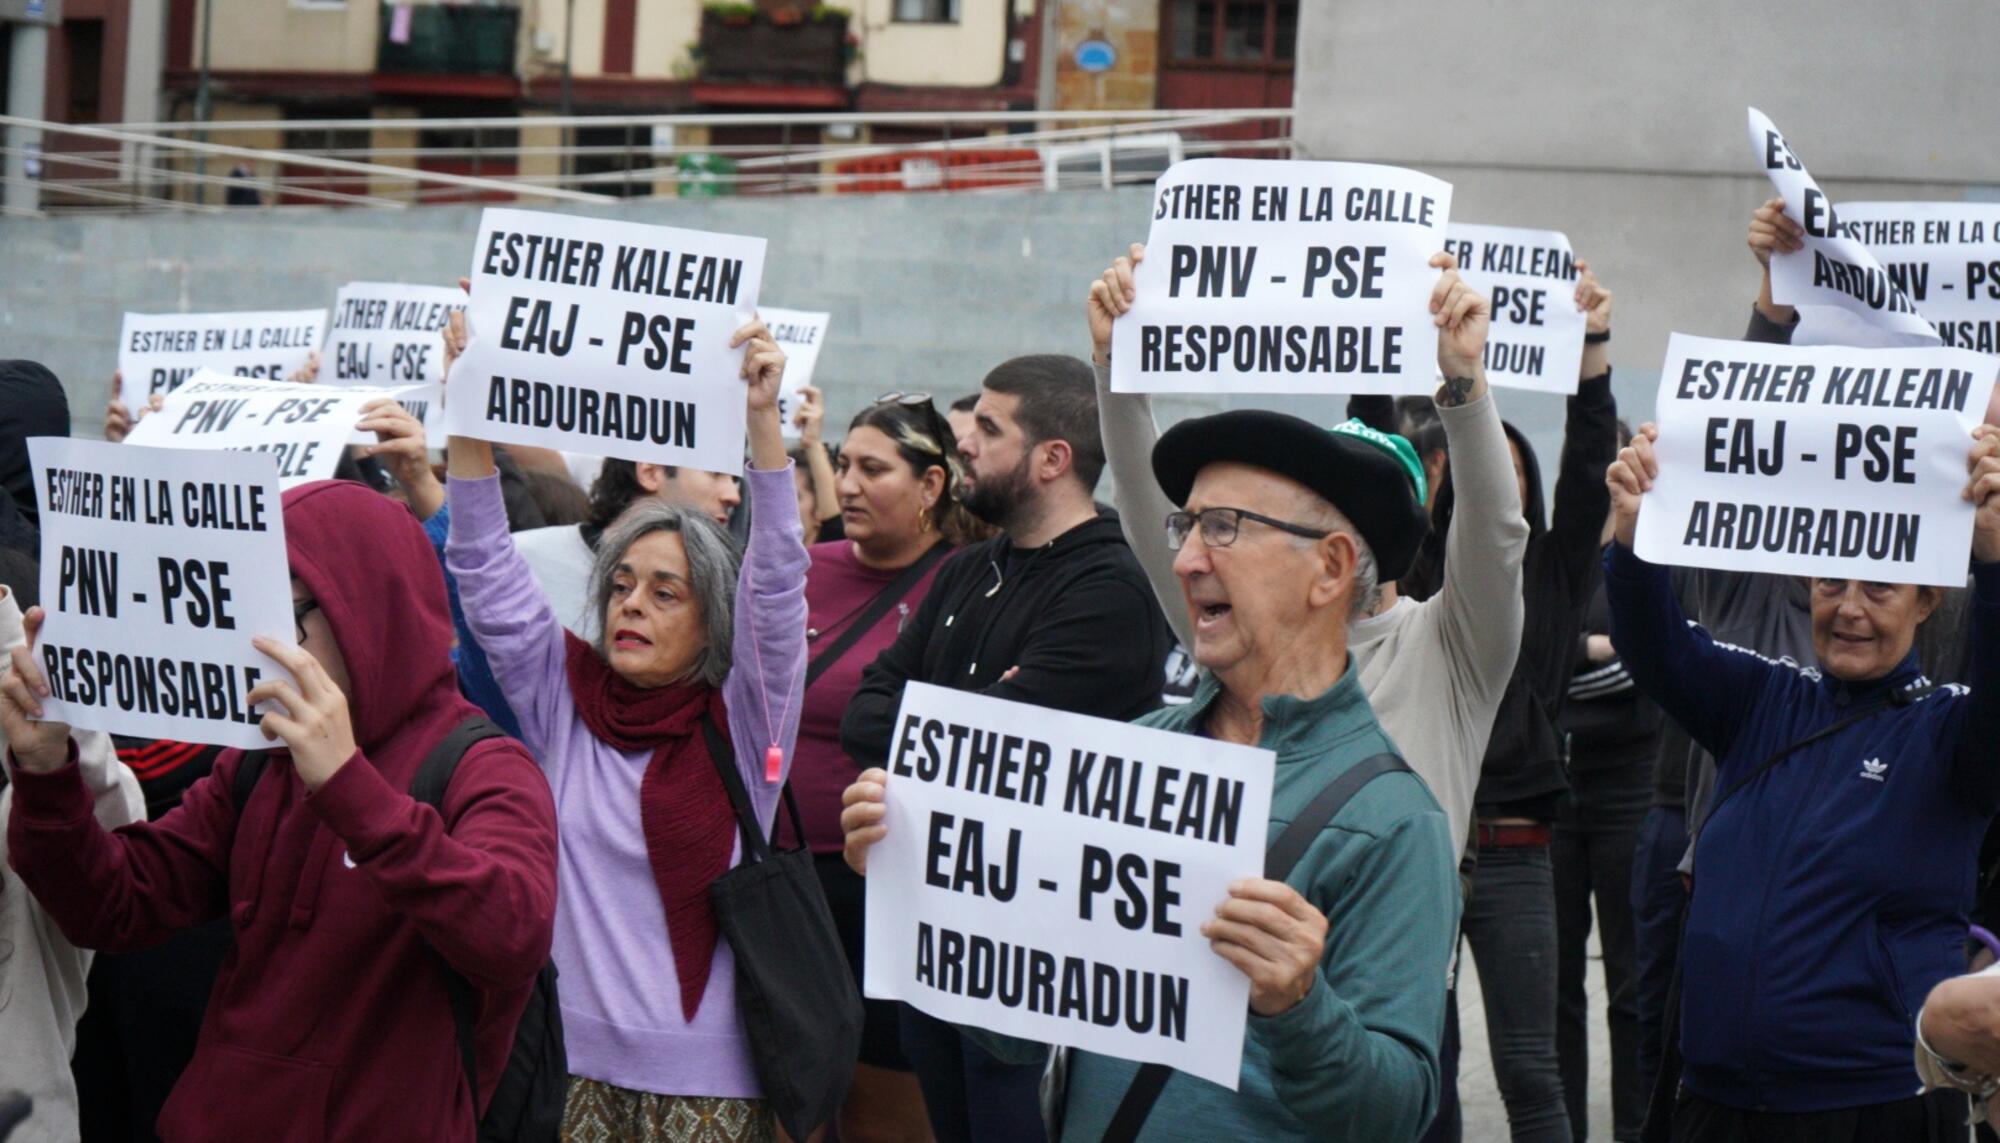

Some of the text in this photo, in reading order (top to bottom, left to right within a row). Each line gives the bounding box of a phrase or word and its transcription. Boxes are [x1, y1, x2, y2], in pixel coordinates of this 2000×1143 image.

[1155, 184, 1435, 228] STHER EN LA CALLE
[1804, 187, 1851, 239] EA
[1849, 220, 1915, 245] STHER
[1923, 220, 1950, 244] EN
[1958, 220, 1984, 244] LA
[482, 231, 743, 306] ESTHER KALEAN
[1168, 244, 1258, 298] PNV
[1270, 275, 1287, 284] -
[1302, 245, 1387, 299] PSE
[1481, 242, 1577, 281] KALEAN
[1885, 263, 1929, 301] NV
[1966, 261, 2000, 300] PS
[334, 298, 467, 331] THER KALEA
[1489, 285, 1547, 326] PSE
[129, 325, 315, 354] ESTHER EN LA CALLE
[336, 341, 431, 382] EAJ - PSE
[500, 296, 696, 375] EAJ - PSE
[1141, 324, 1403, 374] RESPONSABLE
[150, 367, 194, 395] PN
[1676, 358, 1973, 413] ESTHER KALEAN
[172, 399, 249, 435] PNV
[261, 397, 341, 427] PSE
[486, 375, 696, 449] ARDURADUN
[1704, 417, 1918, 485] EAJ - PSE
[45, 467, 267, 532] ESTHER EN LA CALLE
[1682, 500, 1921, 563] ARDURADUN
[58, 545, 236, 631] PNV - PSE
[42, 644, 264, 725] RESPONSABLE
[893, 714, 1245, 847] ESTHER KALEAN
[925, 810, 1182, 938] EAJ - PSE
[916, 921, 1189, 1043] ARDURADUN
